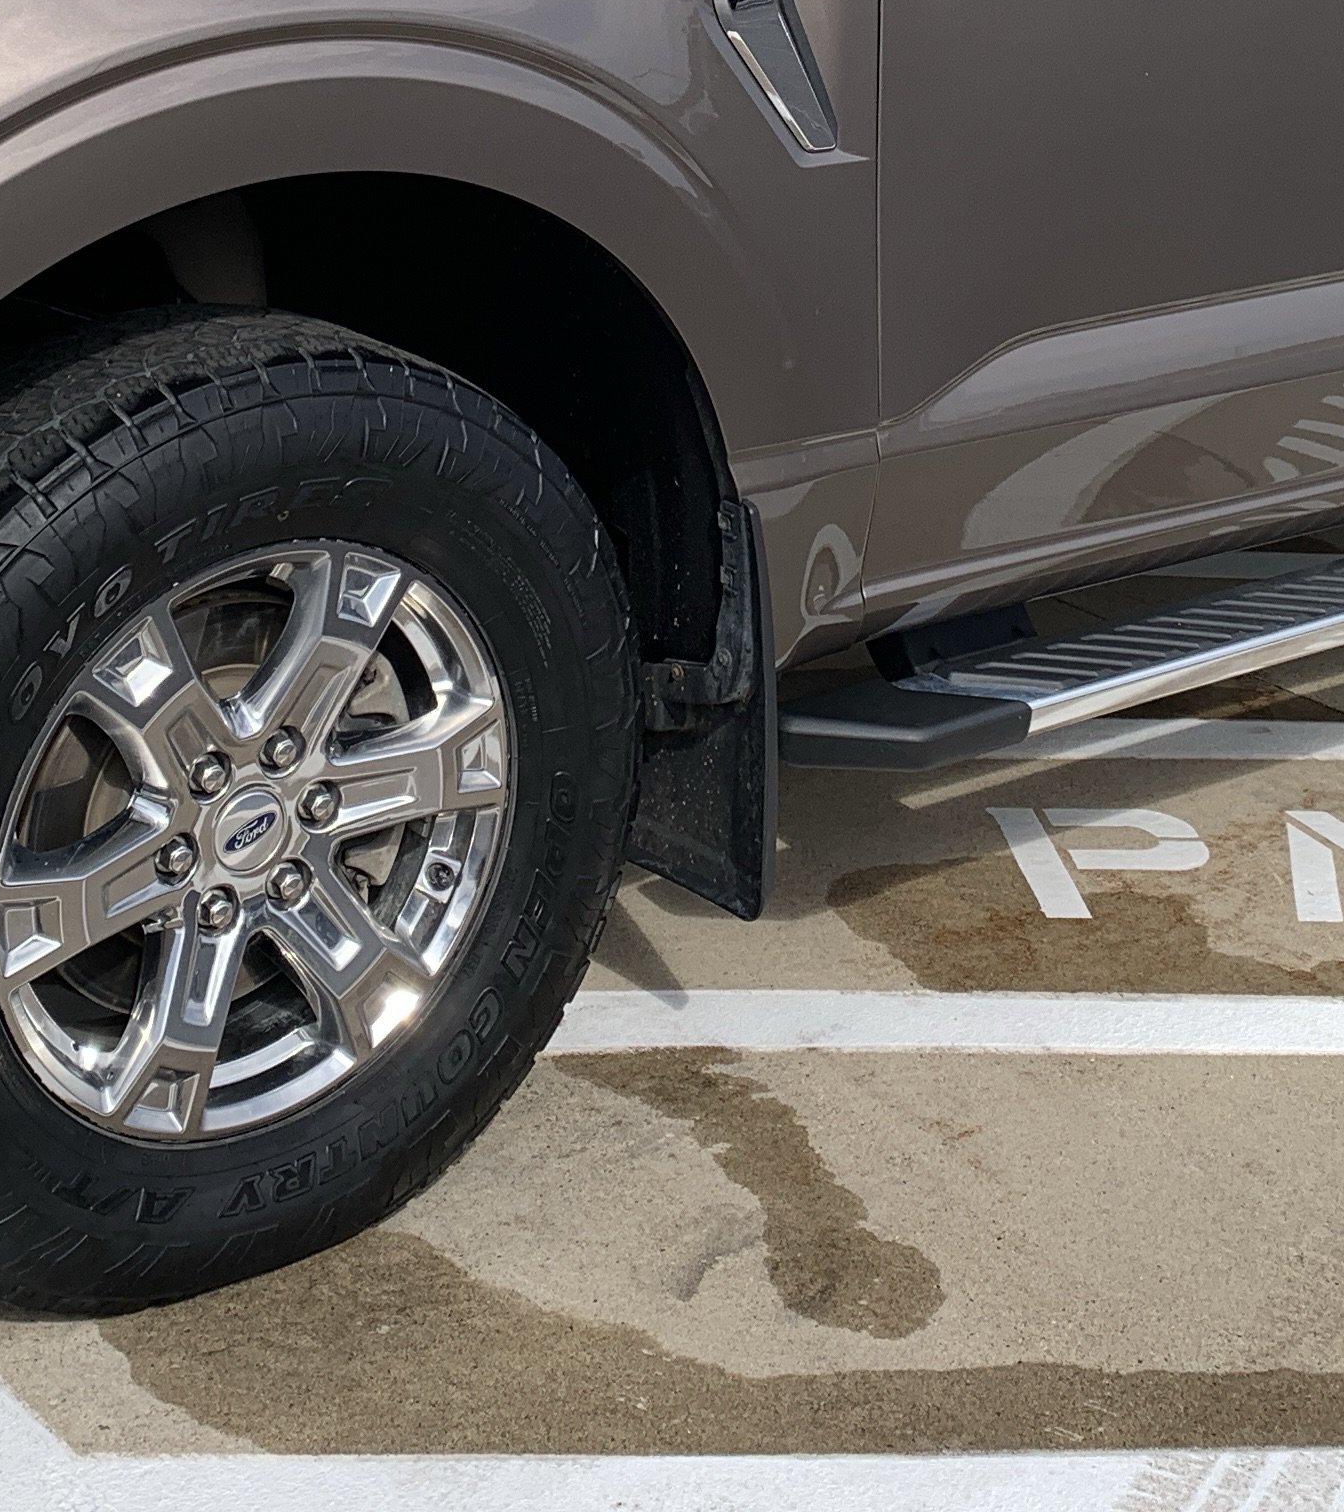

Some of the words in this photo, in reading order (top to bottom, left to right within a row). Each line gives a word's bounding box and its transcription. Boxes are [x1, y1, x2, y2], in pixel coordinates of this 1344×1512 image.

[234, 816, 270, 850] Ford
[501, 769, 578, 985] OPEN
[217, 985, 504, 1220] COUNTRY
